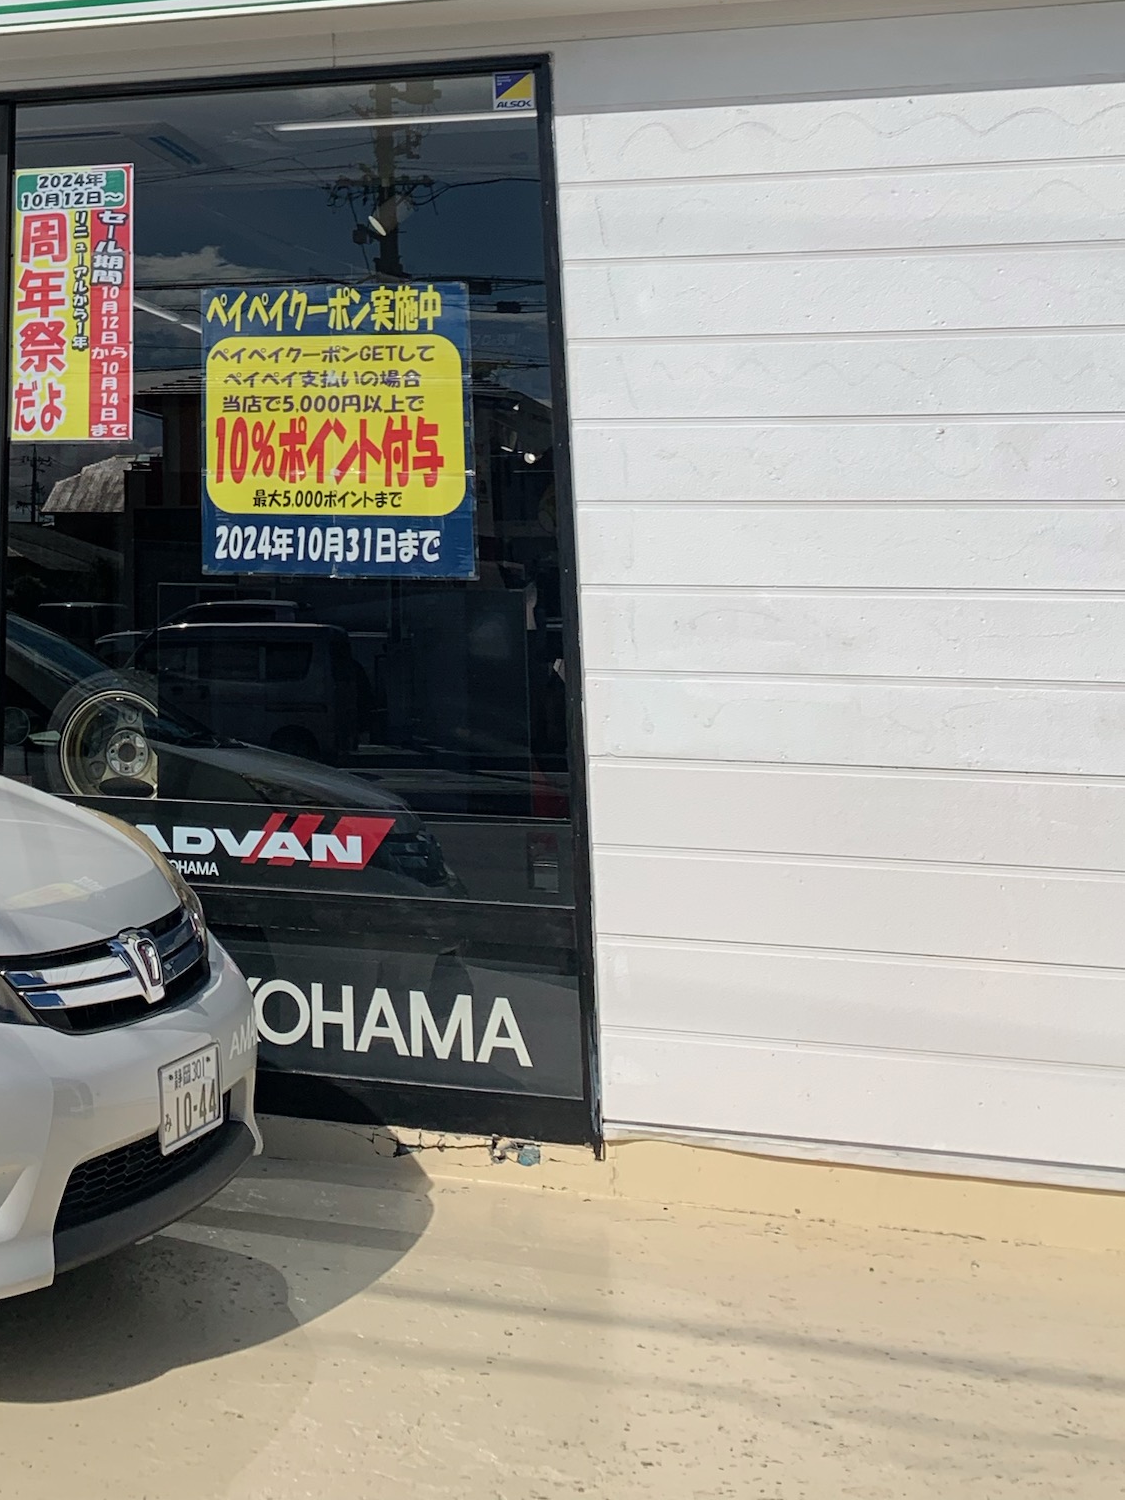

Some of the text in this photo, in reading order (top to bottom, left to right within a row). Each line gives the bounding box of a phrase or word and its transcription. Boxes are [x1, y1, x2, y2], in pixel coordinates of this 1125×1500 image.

[496, 99, 532, 109] ALSOK
[39, 173, 103, 189] 2024年
[72, 210, 90, 351] リニューアルから1年
[14, 212, 68, 432] 周年祭だよ
[91, 210, 128, 436] セール期間 10月12日から10月14日まで
[206, 284, 442, 332] ペイペイクーポン実施中
[211, 345, 435, 362] ペイペイクーポンGETして
[223, 370, 422, 388] ペイペイ支払いの場合
[222, 394, 424, 414] 当店で5,000円以上で
[215, 415, 445, 488] 10%ポイント付与
[252, 489, 403, 509] 最大5,000ポイントまで
[214, 525, 442, 563] 2024年10月31日まで
[192, 1055, 205, 1082] 301
[177, 1079, 217, 1139] 10-44
